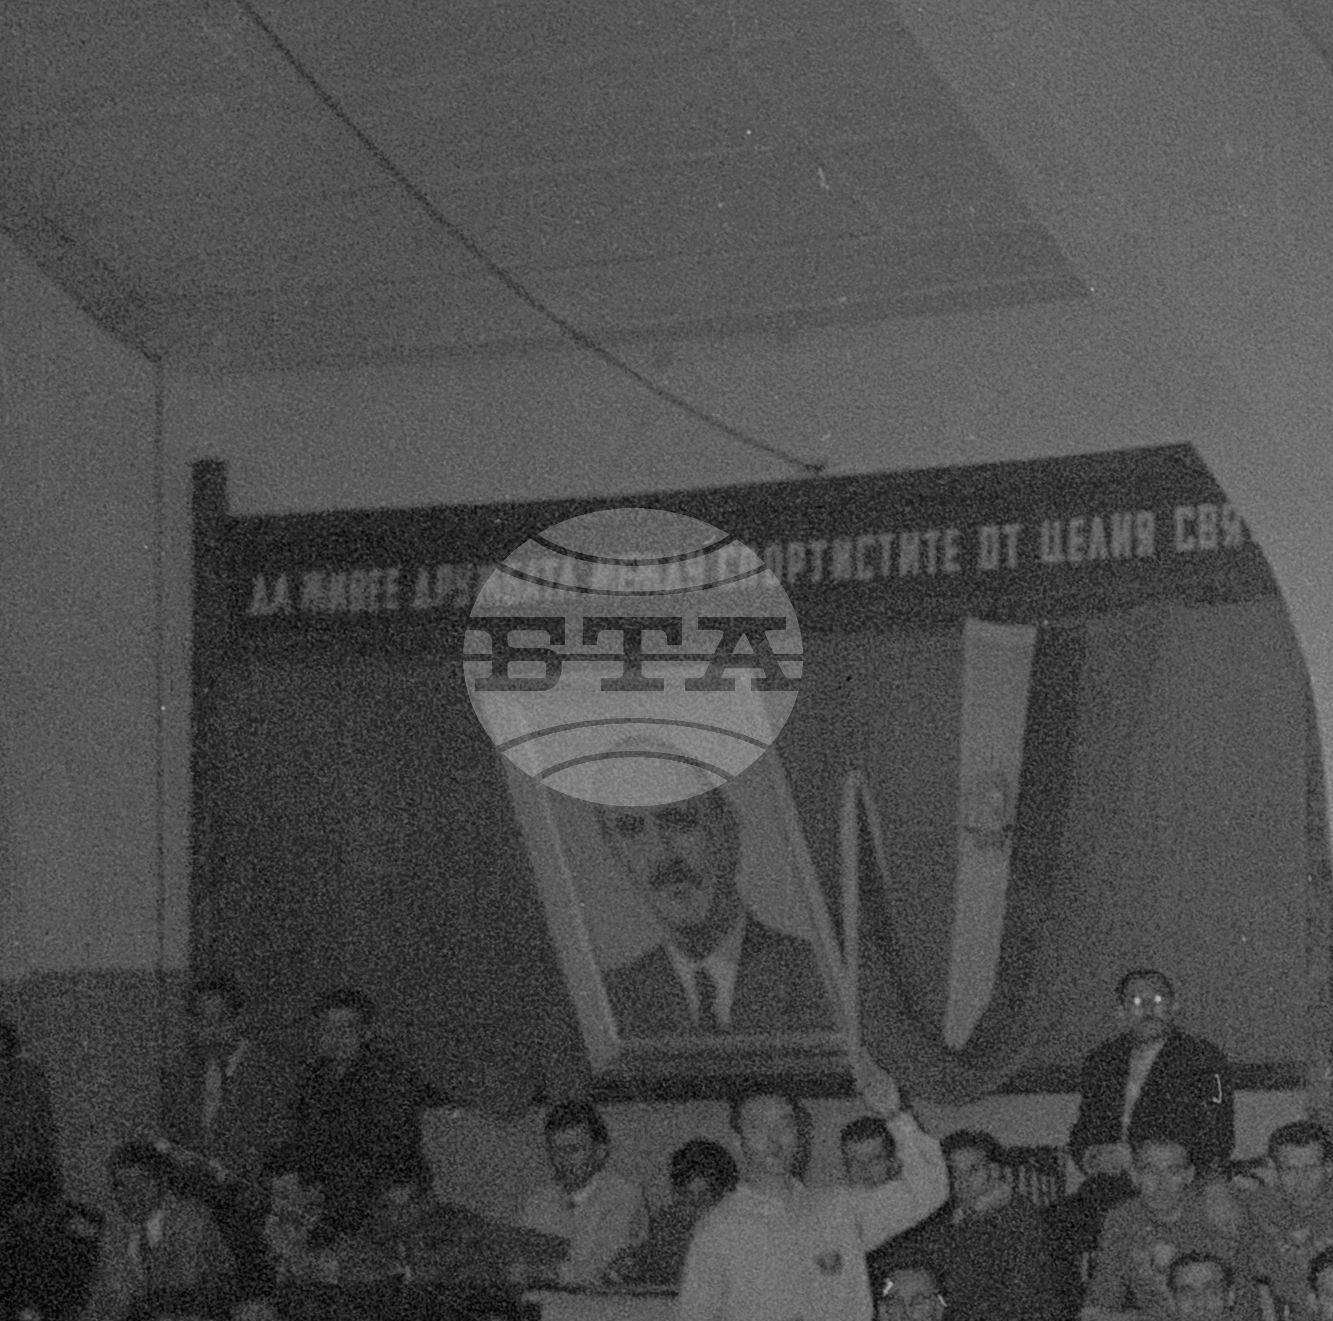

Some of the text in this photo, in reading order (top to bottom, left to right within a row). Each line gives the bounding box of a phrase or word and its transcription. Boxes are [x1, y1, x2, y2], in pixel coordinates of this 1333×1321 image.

[978, 522, 1022, 571] ОТ
[1040, 509, 1155, 564] ЦЕЛИЯ
[1173, 502, 1249, 552] СВЯ
